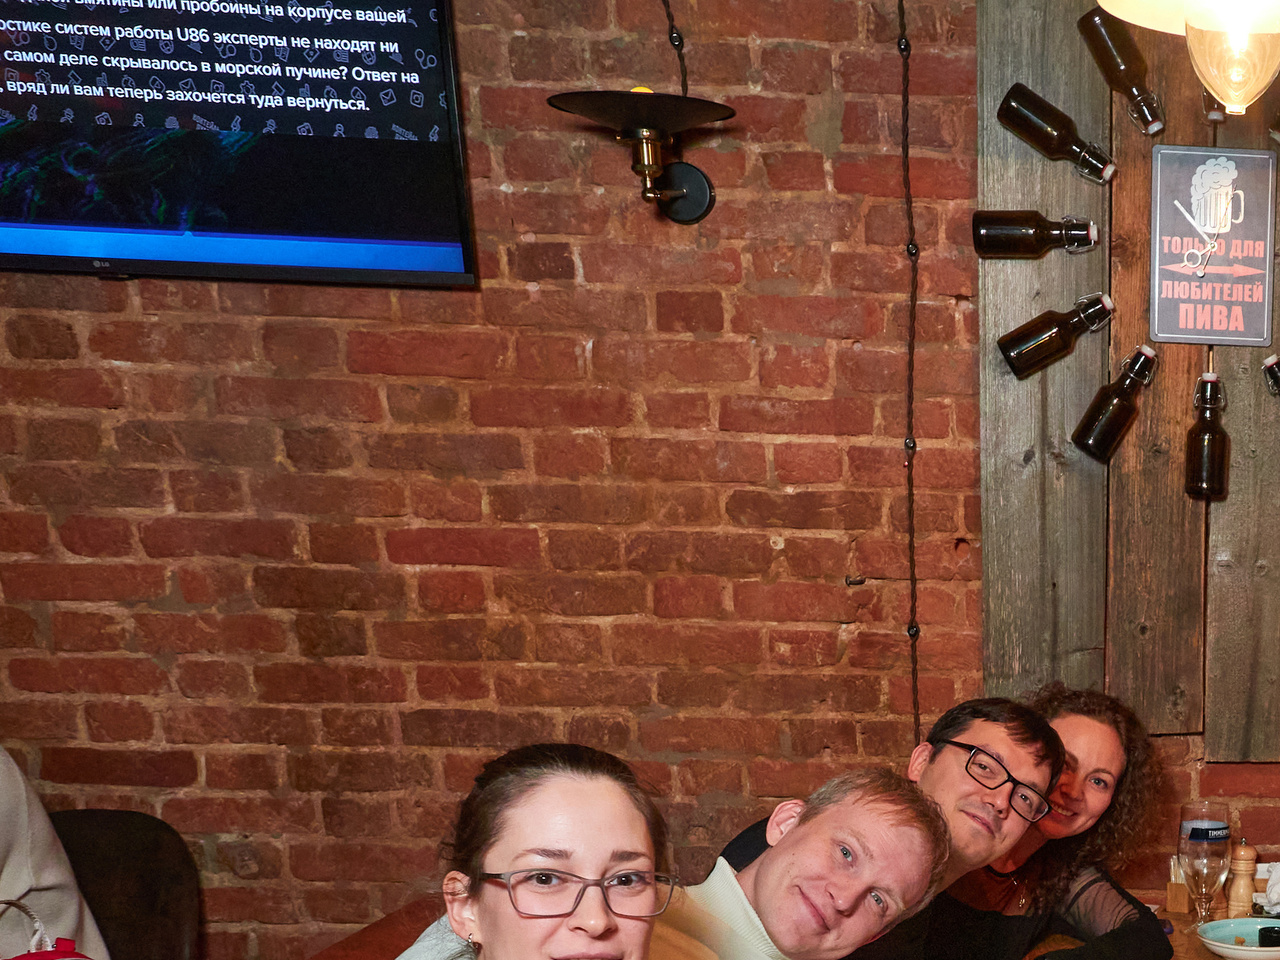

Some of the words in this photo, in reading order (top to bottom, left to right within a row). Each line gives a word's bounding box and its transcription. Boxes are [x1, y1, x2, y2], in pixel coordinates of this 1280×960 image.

[148, 0, 177, 9] или
[181, 0, 261, 15] пробоины
[264, 4, 284, 16] на
[288, 6, 352, 22] корпусе
[356, 8, 407, 23] вашей
[55, 23, 110, 36] систем
[115, 25, 173, 40] работы
[177, 27, 209, 42] U86
[213, 32, 287, 47] эксперты
[291, 37, 310, 48] не
[314, 38, 375, 52] находят
[380, 42, 399, 53] ни
[4, 50, 55, 63] самом
[59, 53, 98, 66] деле
[102, 56, 197, 72] скрывалось
[201, 62, 211, 72] в
[215, 62, 281, 78] морской
[286, 66, 347, 81] пучине?
[352, 67, 397, 83] Ответ
[401, 72, 420, 84] на
[6, 80, 47, 96] вряд
[50, 83, 70, 95] ли
[73, 85, 104, 97] вам
[107, 86, 163, 102] теперь
[166, 89, 245, 105] захочется
[249, 93, 283, 107] туда
[287, 95, 370, 112] вернуться.
[1229, 240, 1265, 259] ДЛЯ
[1161, 280, 1263, 303] ЛЮБИТЕЛЕЙ
[1179, 303, 1245, 332] ПИВА
